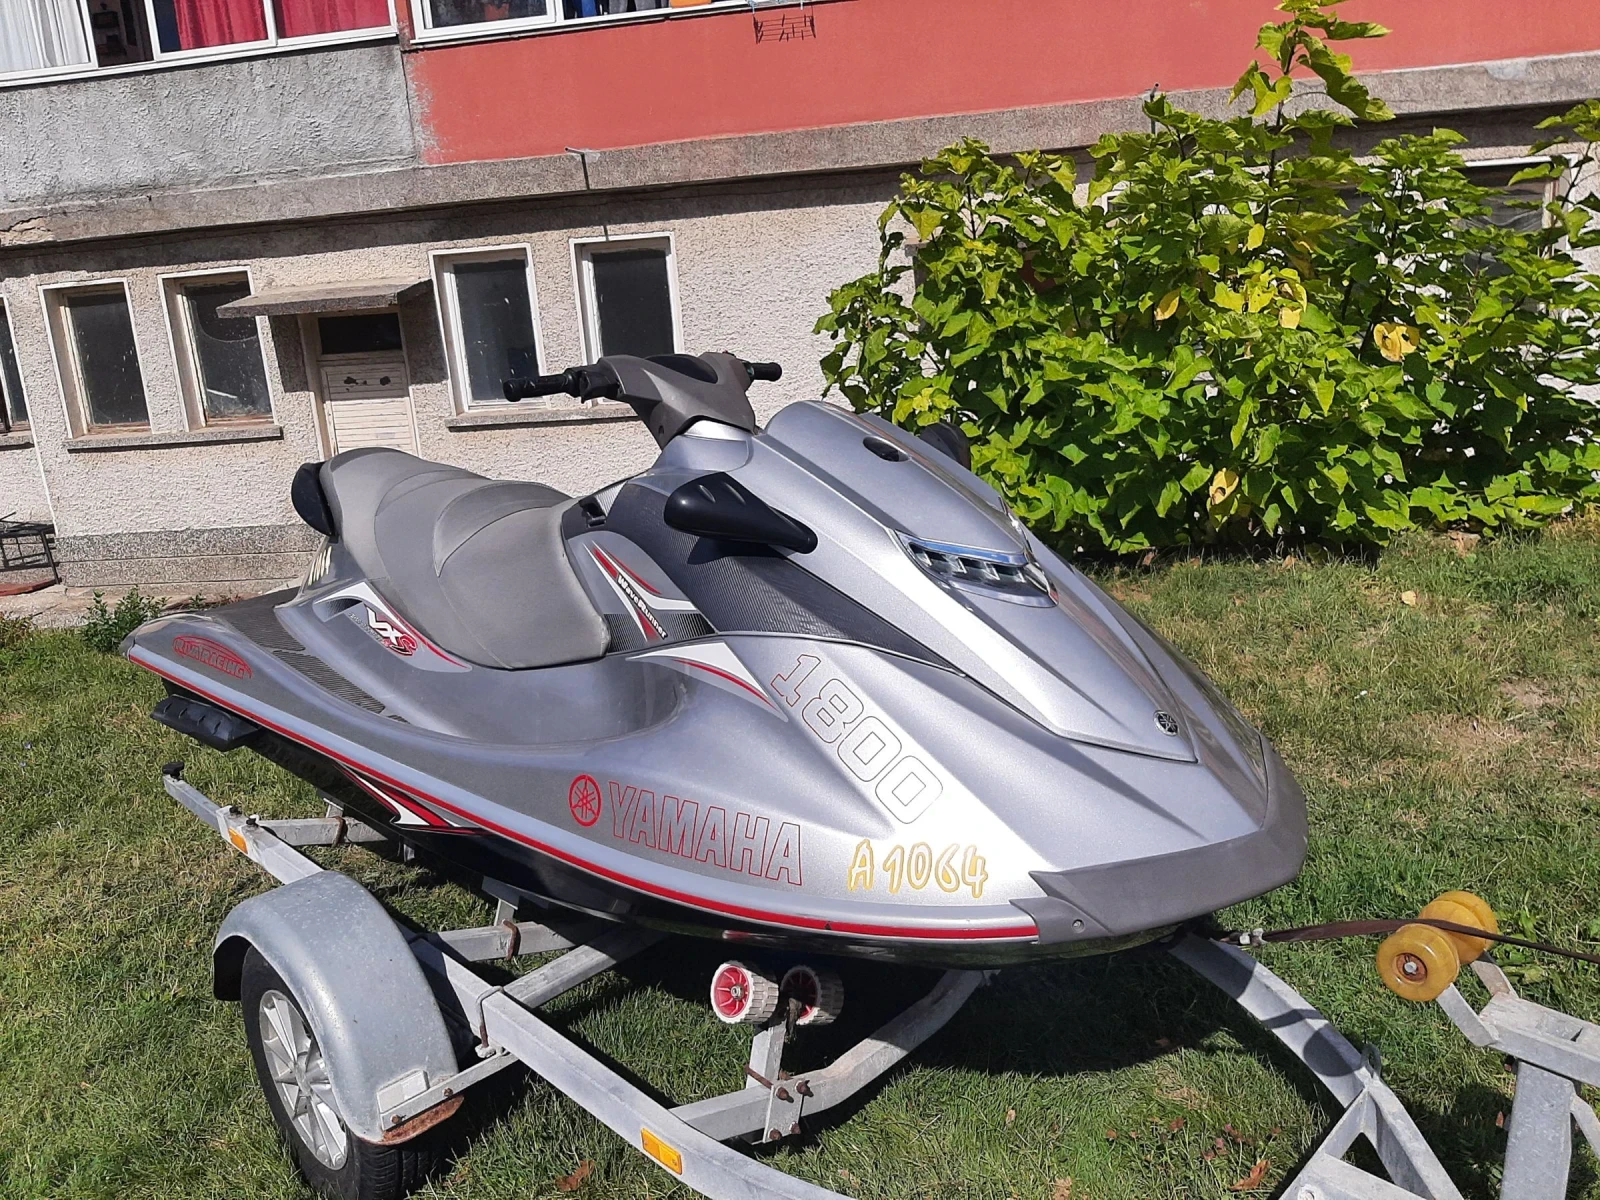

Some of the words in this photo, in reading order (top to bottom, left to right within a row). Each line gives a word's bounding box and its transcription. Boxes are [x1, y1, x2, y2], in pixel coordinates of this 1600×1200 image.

[617, 575, 667, 638] WaveRunner
[771, 654, 943, 824] 1800
[609, 781, 802, 885] YAMAHA
[883, 842, 988, 898] 1064
